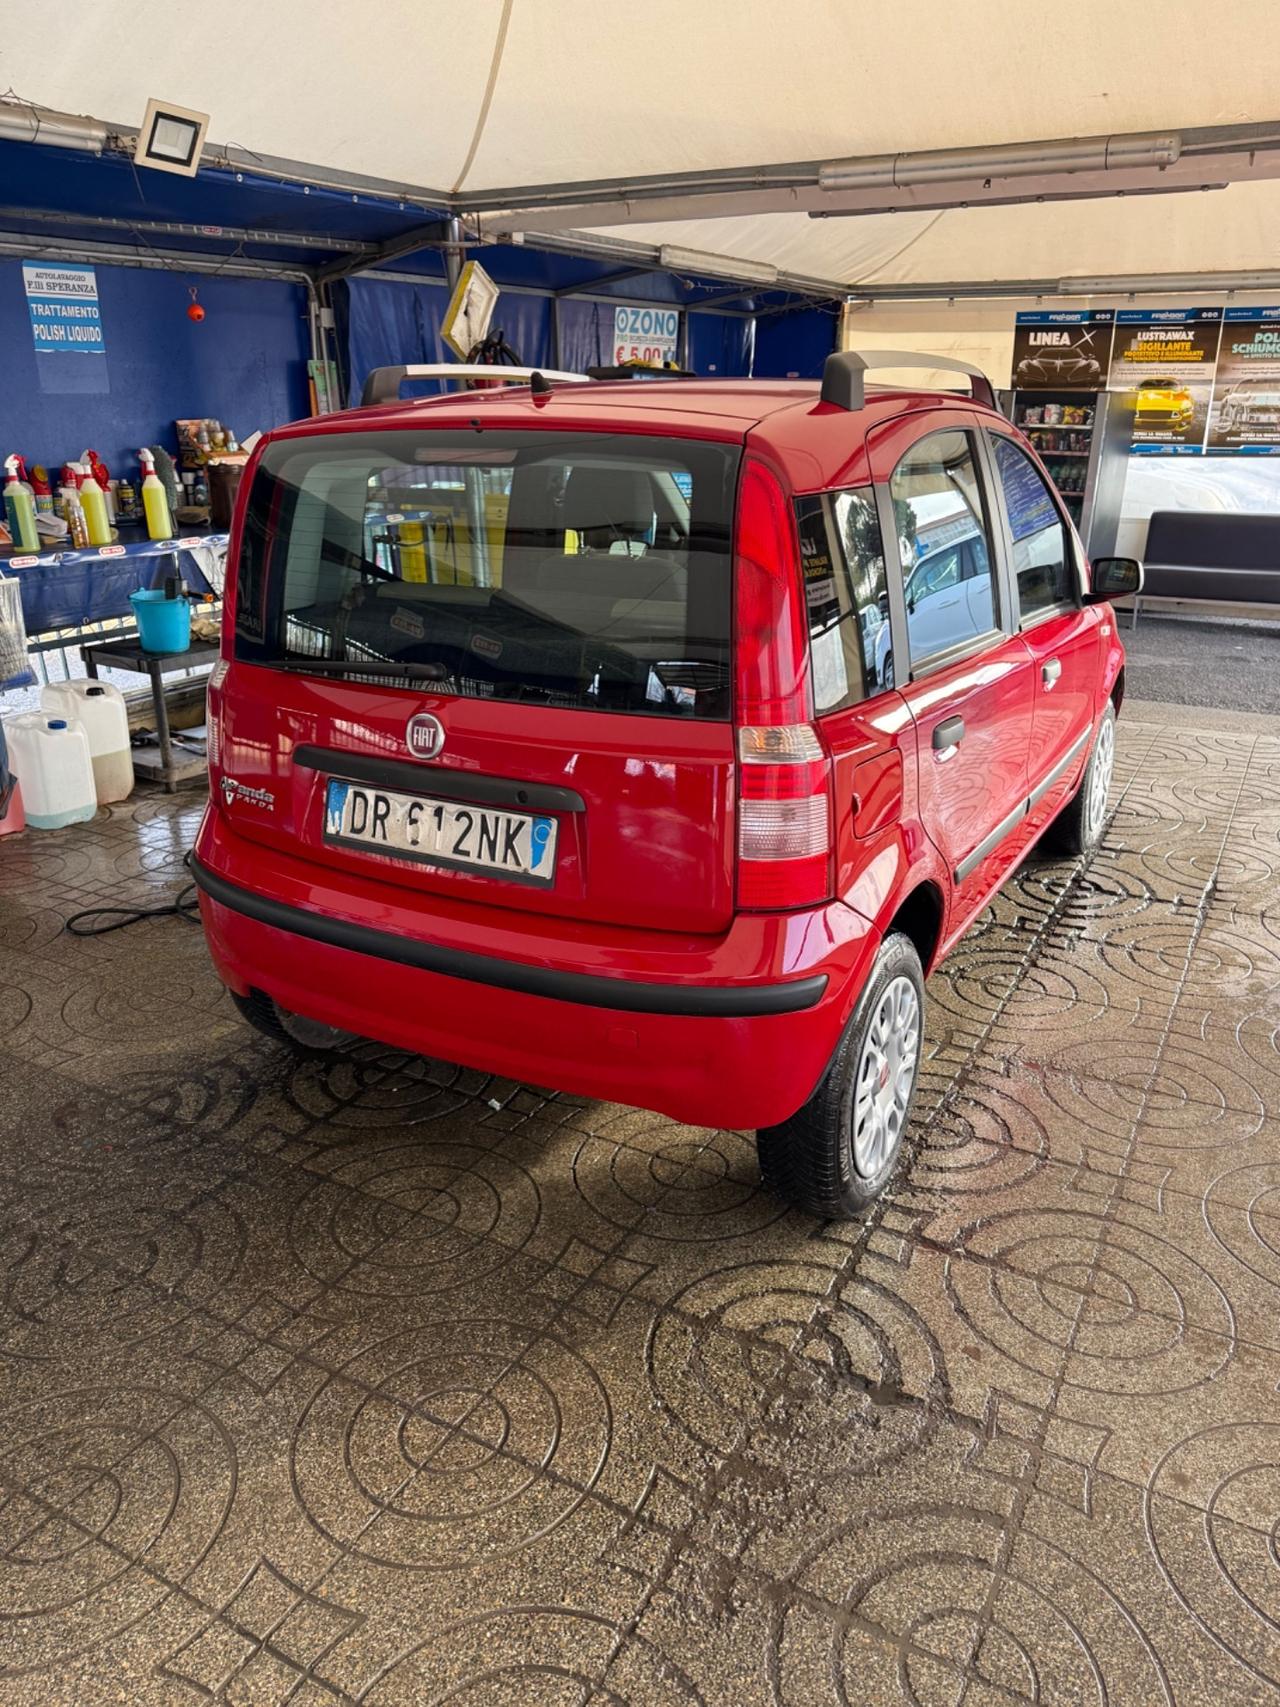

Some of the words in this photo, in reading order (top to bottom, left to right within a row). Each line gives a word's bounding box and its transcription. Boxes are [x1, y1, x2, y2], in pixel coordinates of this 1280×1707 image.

[46, 282, 96, 293] SPERANZA
[31, 304, 99, 318] TRATTAMENTO
[616, 308, 677, 336] OZONO
[33, 324, 66, 341] POLISH
[67, 326, 102, 342] LIQUIDO
[1028, 332, 1071, 346] LINEA
[1137, 331, 1195, 341] LUSTRAWAX
[1138, 341, 1192, 351] SIGILLANTE
[630, 346, 661, 362] 500
[413, 726, 436, 748] FIAT
